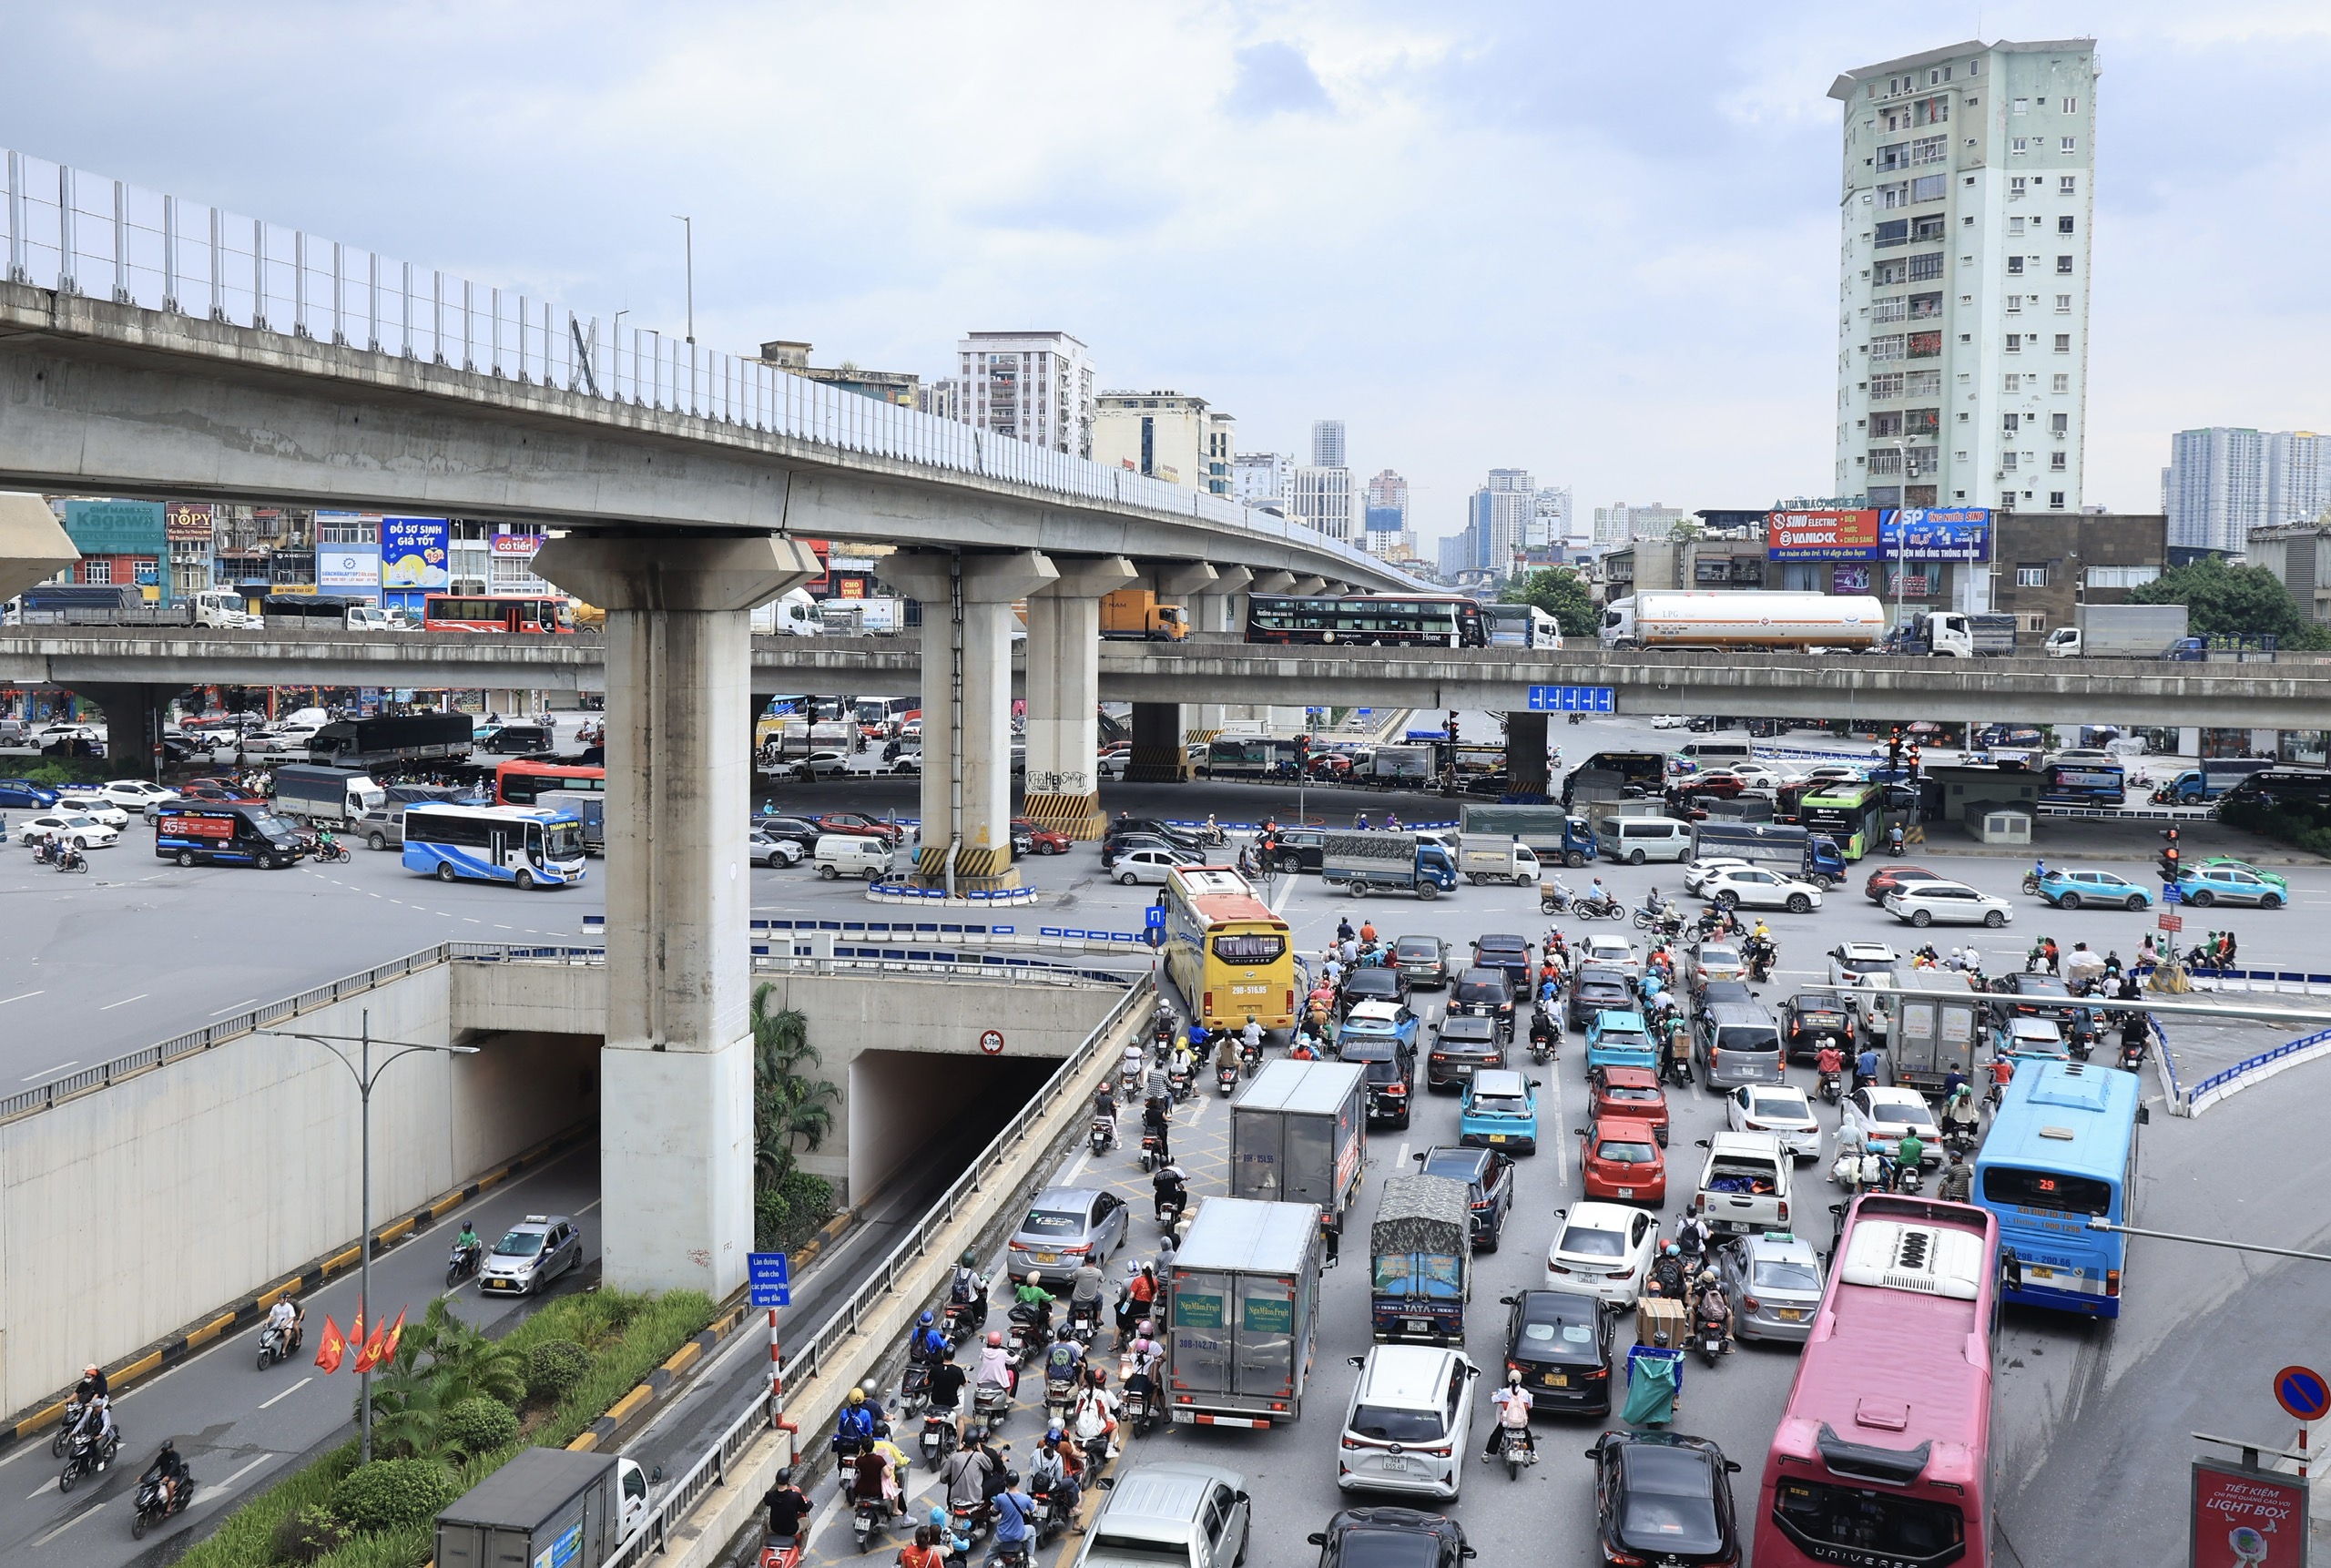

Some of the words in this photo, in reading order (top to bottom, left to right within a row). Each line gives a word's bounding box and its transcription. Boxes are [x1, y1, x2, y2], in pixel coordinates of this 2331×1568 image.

[168, 514, 211, 525] TOPY
[1786, 514, 1807, 527] SINO
[1808, 517, 1837, 526] ELECTRIC
[1943, 511, 1963, 523] NƯỚC
[1965, 511, 1984, 522] SINO
[390, 521, 403, 534] ĐỒ
[405, 524, 419, 534] SƠ
[420, 524, 442, 534] SINH
[416, 534, 435, 545] TỐT
[1792, 532, 1837, 544] VANLOCK
[499, 540, 513, 550] có
[1887, 549, 1898, 558] PHỤ
[1903, 548, 1913, 558] IỆN
[1915, 547, 1926, 557] NỐI
[1927, 547, 1939, 557] ỐNG
[1940, 548, 1960, 557] THÔNG
[162, 821, 178, 833] 5G
[549, 822, 566, 831] THÀNH
[2040, 1179, 2054, 1190] 29
[2031, 1207, 2047, 1217] BUS
[763, 1257, 779, 1267] đường
[2017, 1252, 2032, 1262] 29B
[2041, 1256, 2071, 1268] 200.66
[760, 1282, 778, 1291] phương
[758, 1296, 770, 1304] quay
[1403, 1305, 1430, 1313] TATA
[1179, 1339, 1217, 1350] 30B-142.70
[2225, 1483, 2249, 1493] TIẾT
[2249, 1487, 2280, 1498] KIỆM
[2238, 1494, 2263, 1502] QUẢNG
[2206, 1498, 2254, 1513] LIGHT
[2254, 1505, 2290, 1520] BOX
